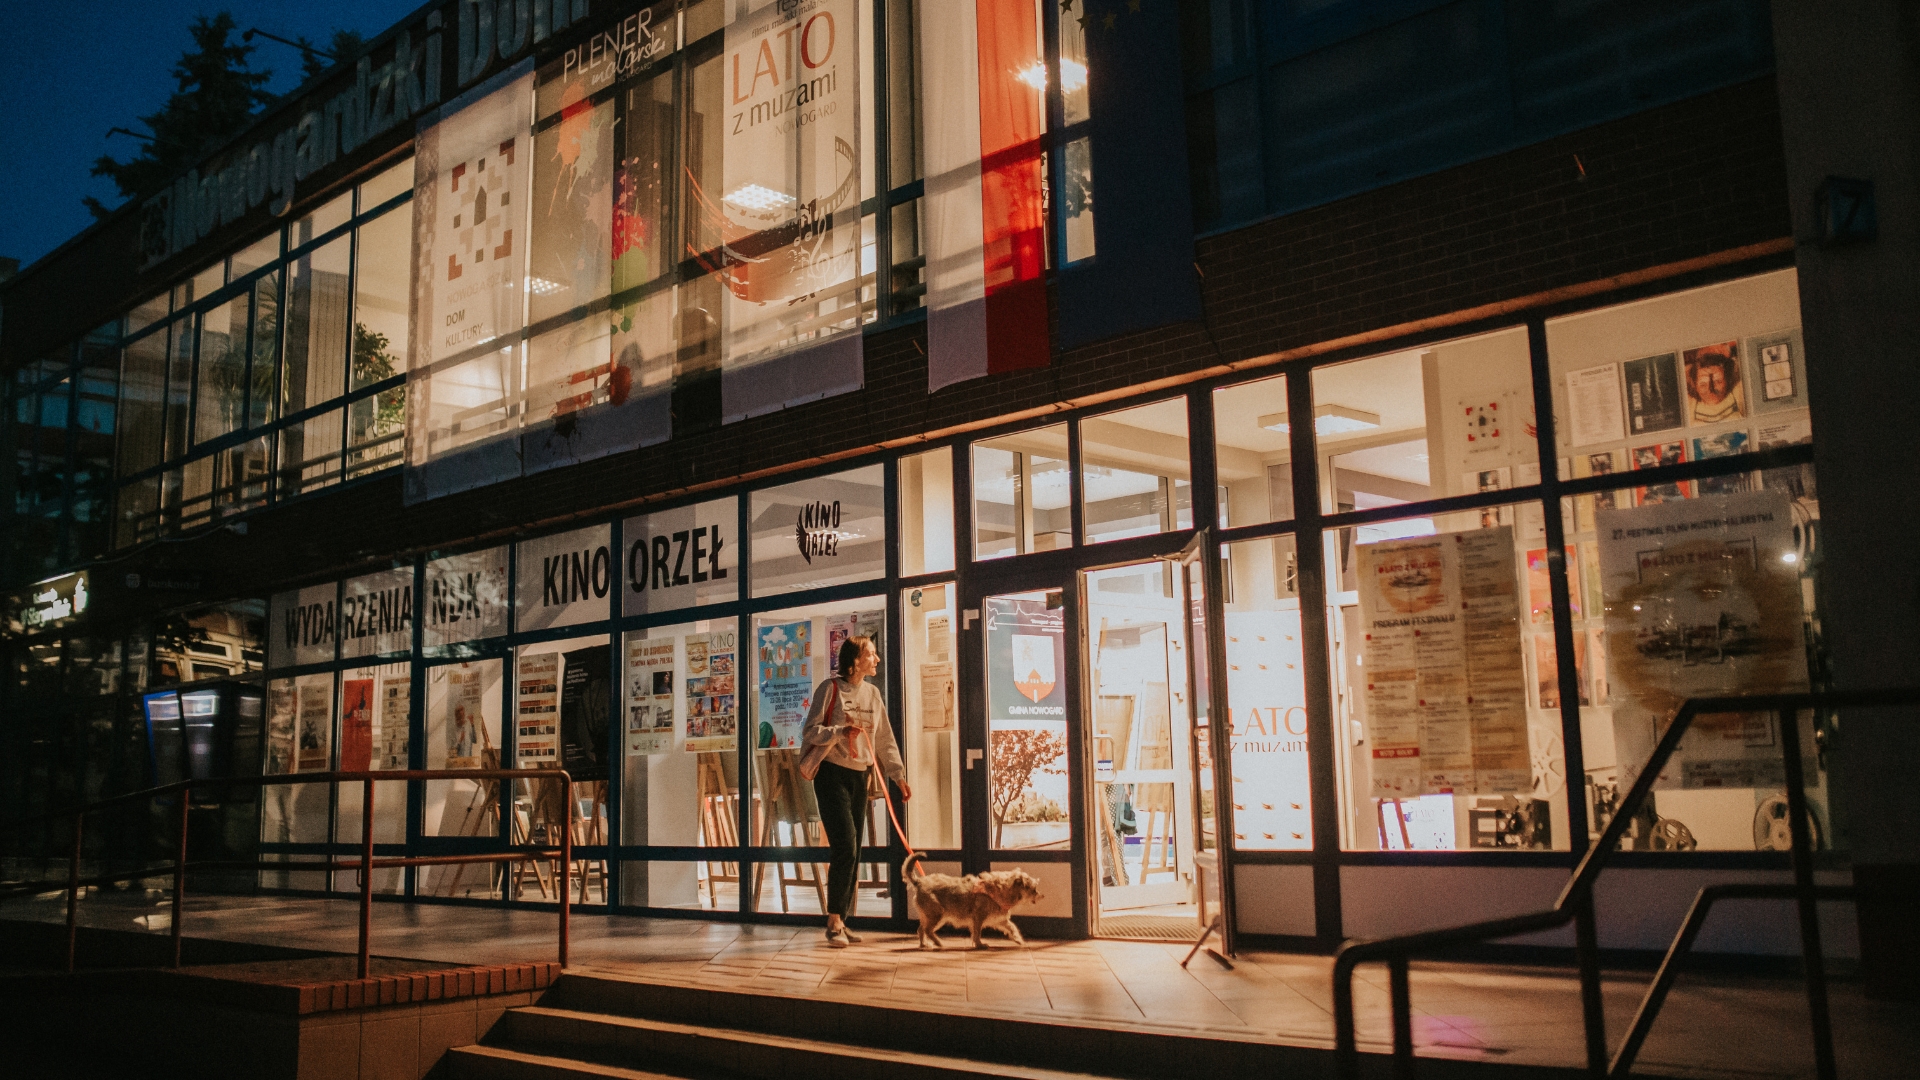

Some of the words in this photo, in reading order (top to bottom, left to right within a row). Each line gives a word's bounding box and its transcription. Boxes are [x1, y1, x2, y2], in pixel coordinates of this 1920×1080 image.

[563, 7, 652, 84] PLENER
[733, 10, 836, 106] LATO
[732, 112, 744, 136] z
[750, 64, 837, 127] muzami
[775, 101, 837, 138] NOWOGARD
[445, 322, 484, 348] KULTURY
[446, 309, 466, 327] DOM
[804, 500, 841, 529] KINO
[543, 545, 611, 607] KINO
[628, 524, 728, 594] ORZEŁ
[285, 585, 412, 649] WYDARZENIA
[710, 632, 735, 649] KINO
[1228, 706, 1308, 737] LATO
[1244, 740, 1309, 754] muzam
